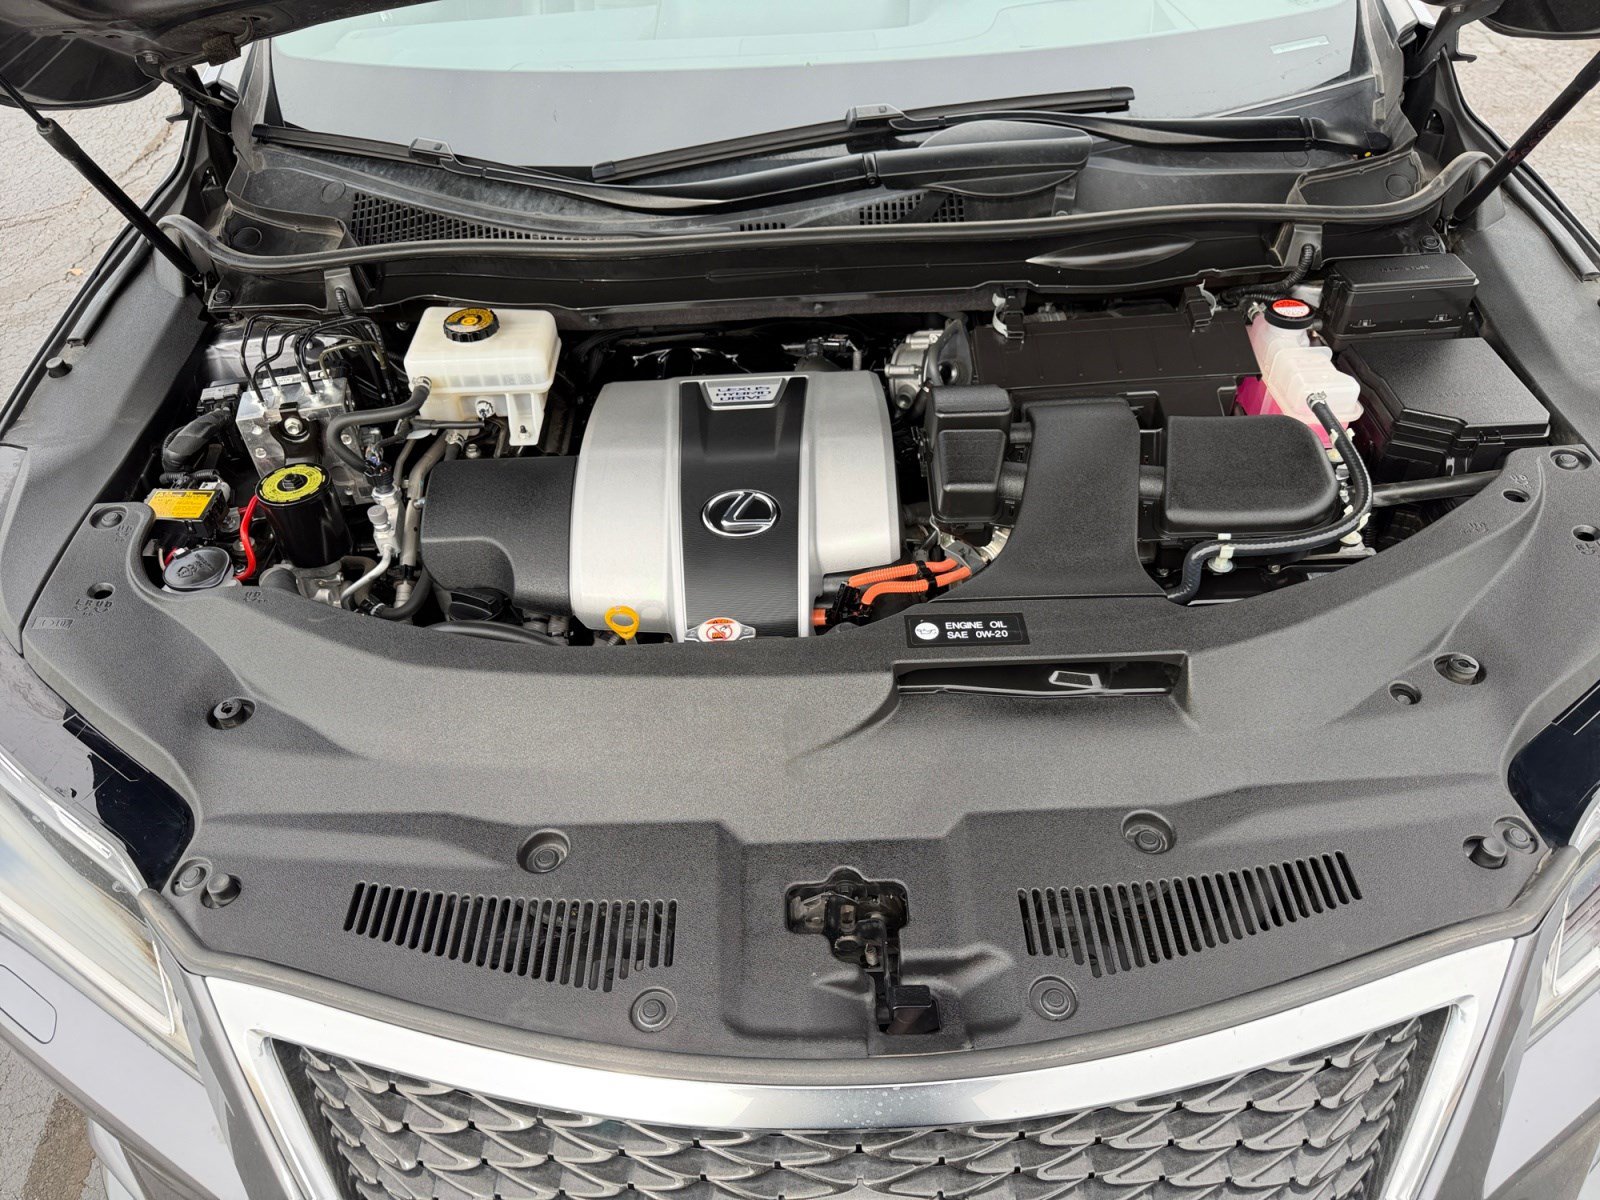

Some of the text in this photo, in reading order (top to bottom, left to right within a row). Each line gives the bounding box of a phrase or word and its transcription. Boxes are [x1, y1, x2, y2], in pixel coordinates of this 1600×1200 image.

[945, 620, 1007, 629] ENGINE OIL
[947, 630, 1009, 639] SAE 0W-20
